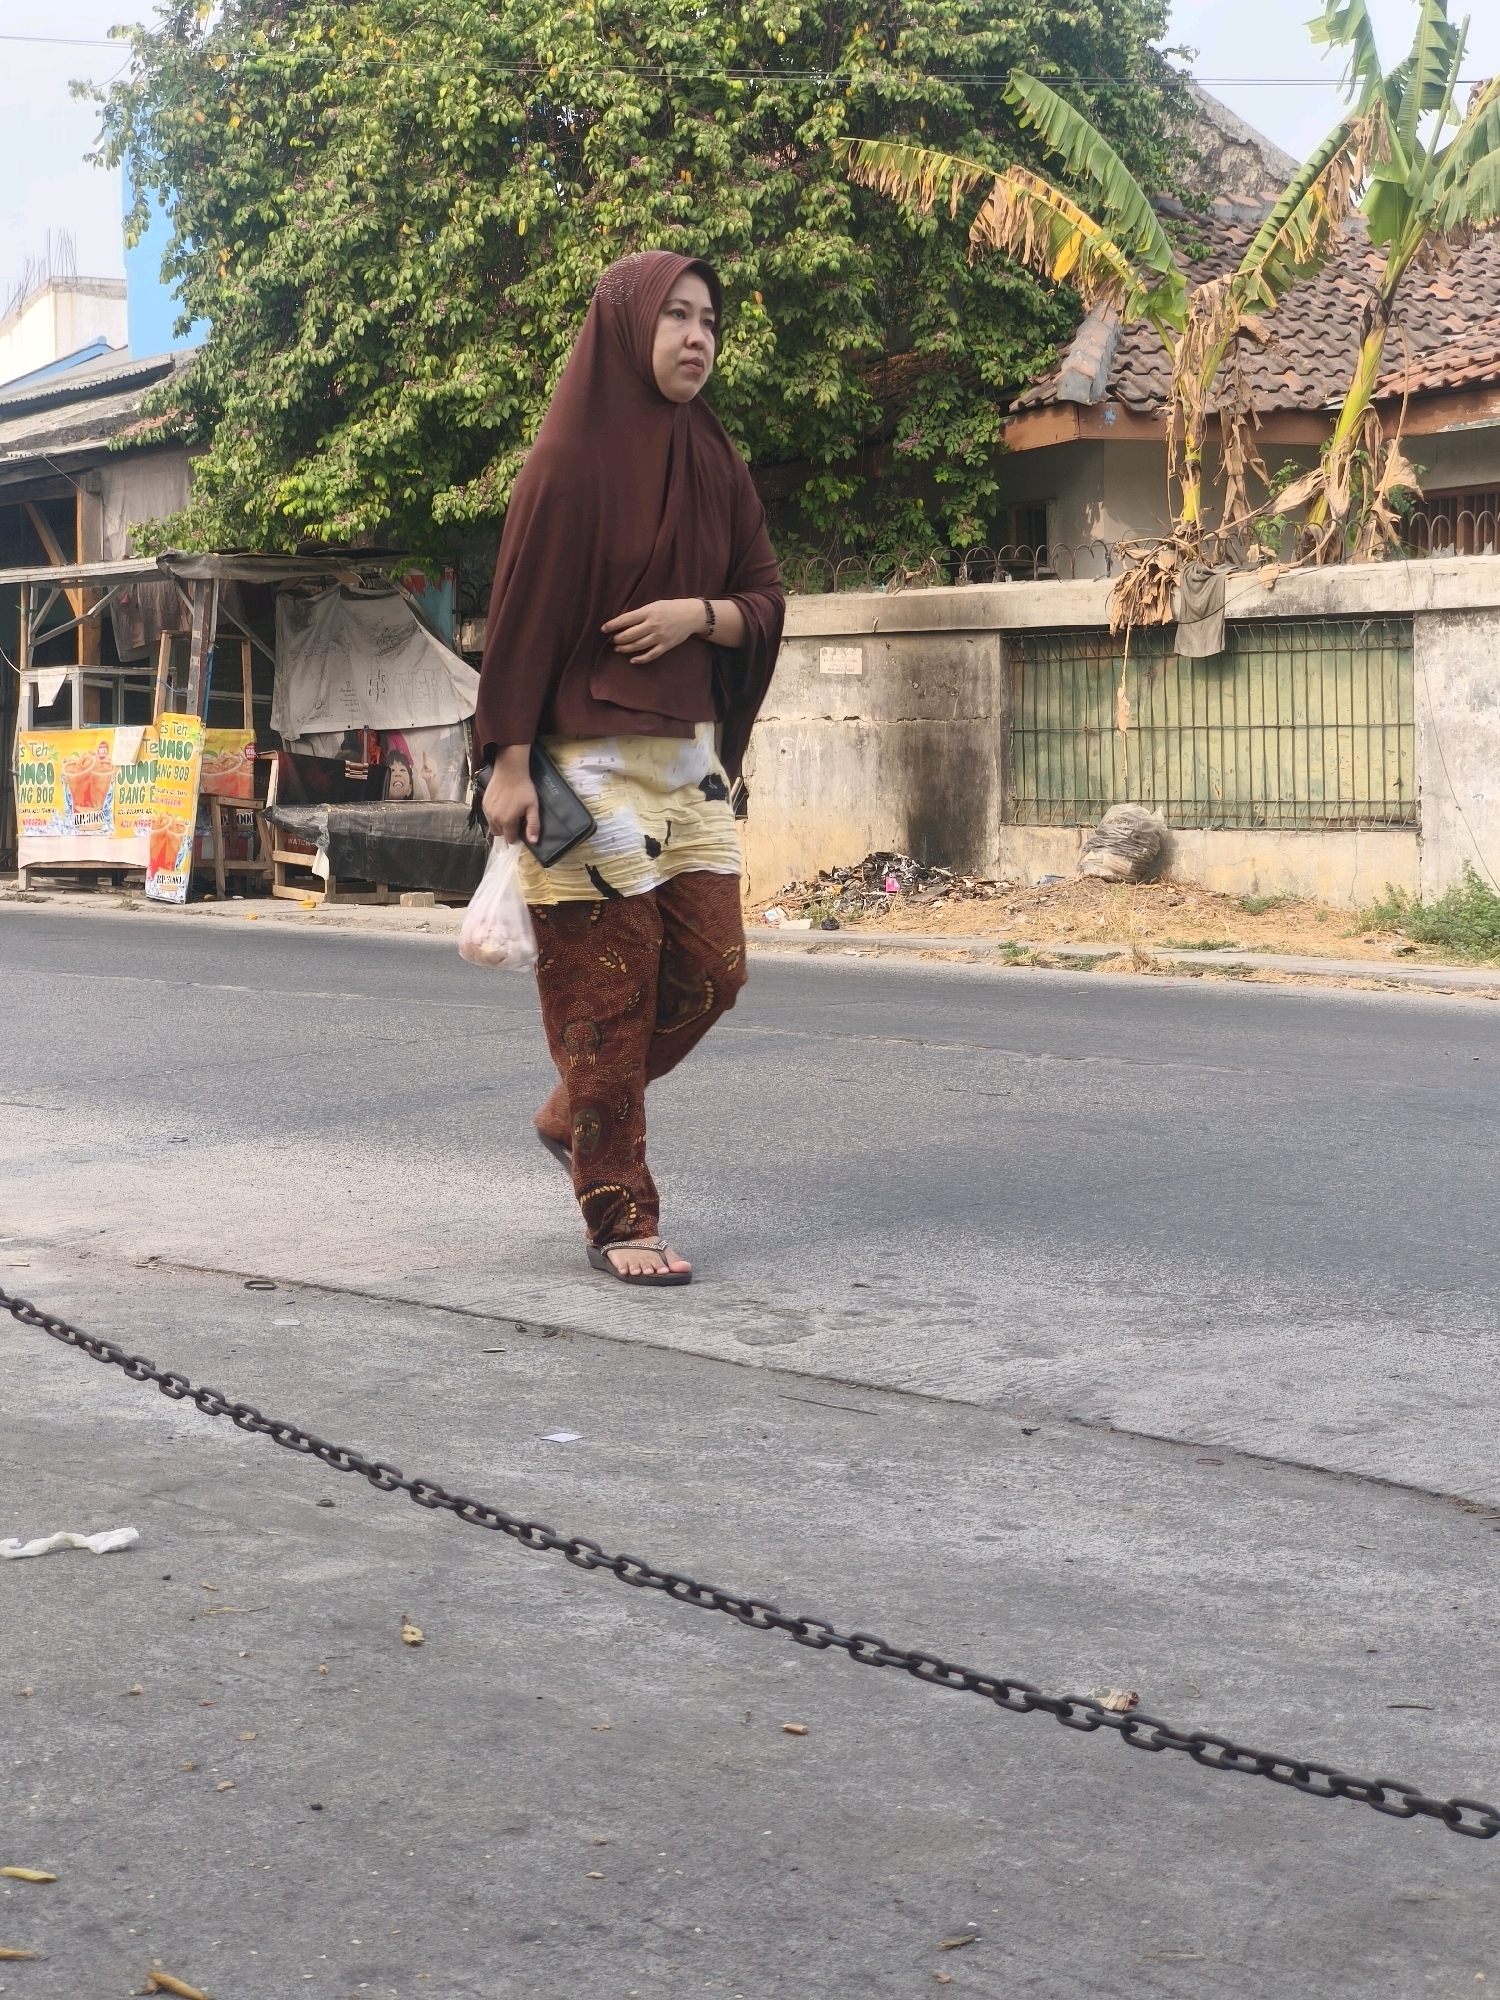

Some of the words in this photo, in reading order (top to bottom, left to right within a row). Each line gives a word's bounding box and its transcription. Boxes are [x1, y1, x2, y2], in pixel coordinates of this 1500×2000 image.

[172, 721, 188, 736] Teh
[29, 741, 48, 757] Teh
[174, 766, 190, 781] BOB
[36, 787, 55, 803] BOB
[119, 786, 146, 804] BANG
